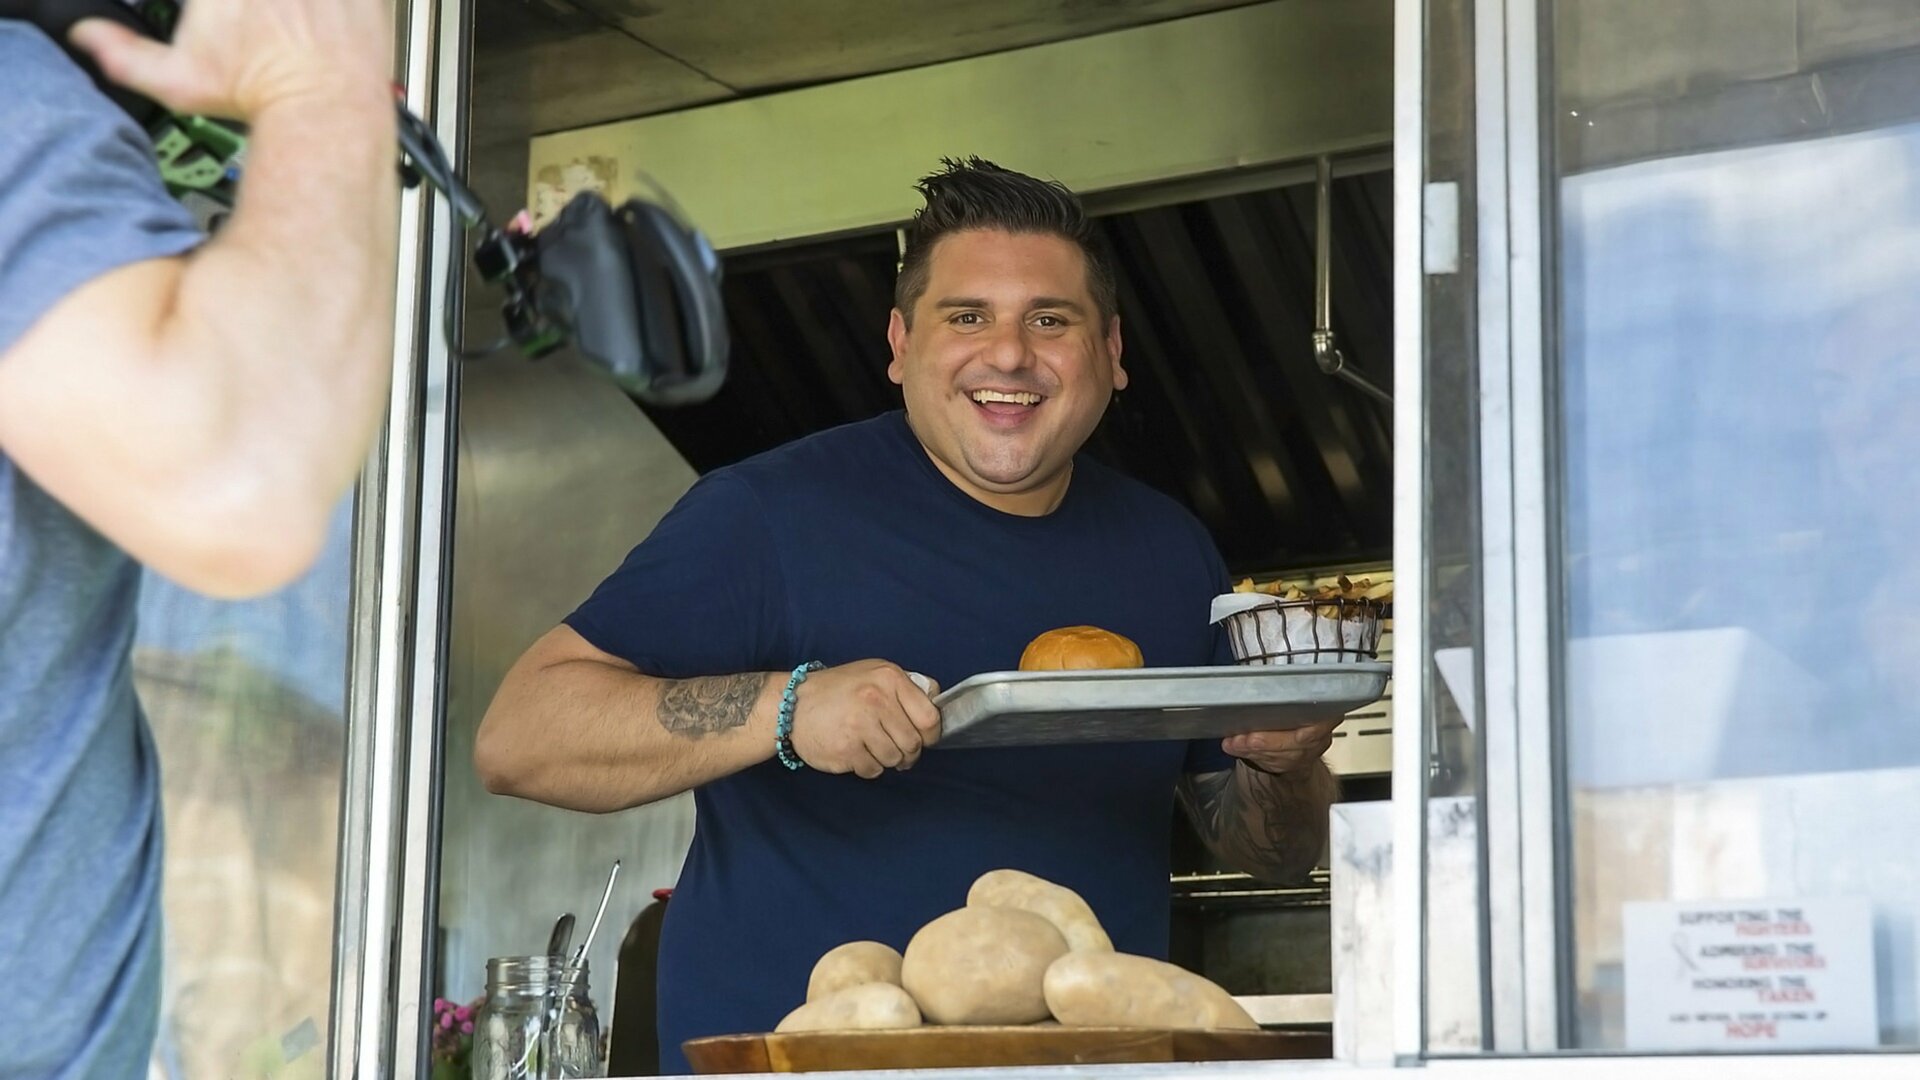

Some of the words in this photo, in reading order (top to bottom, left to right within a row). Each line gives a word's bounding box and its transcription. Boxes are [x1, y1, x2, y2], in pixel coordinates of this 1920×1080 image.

[1679, 910, 1768, 925] SUPPORTING
[1778, 909, 1803, 921] THE
[1785, 943, 1815, 955] THE
[1780, 976, 1805, 987] THE
[1758, 989, 1815, 1003] TAKEN
[1727, 1023, 1778, 1038] HOPE
